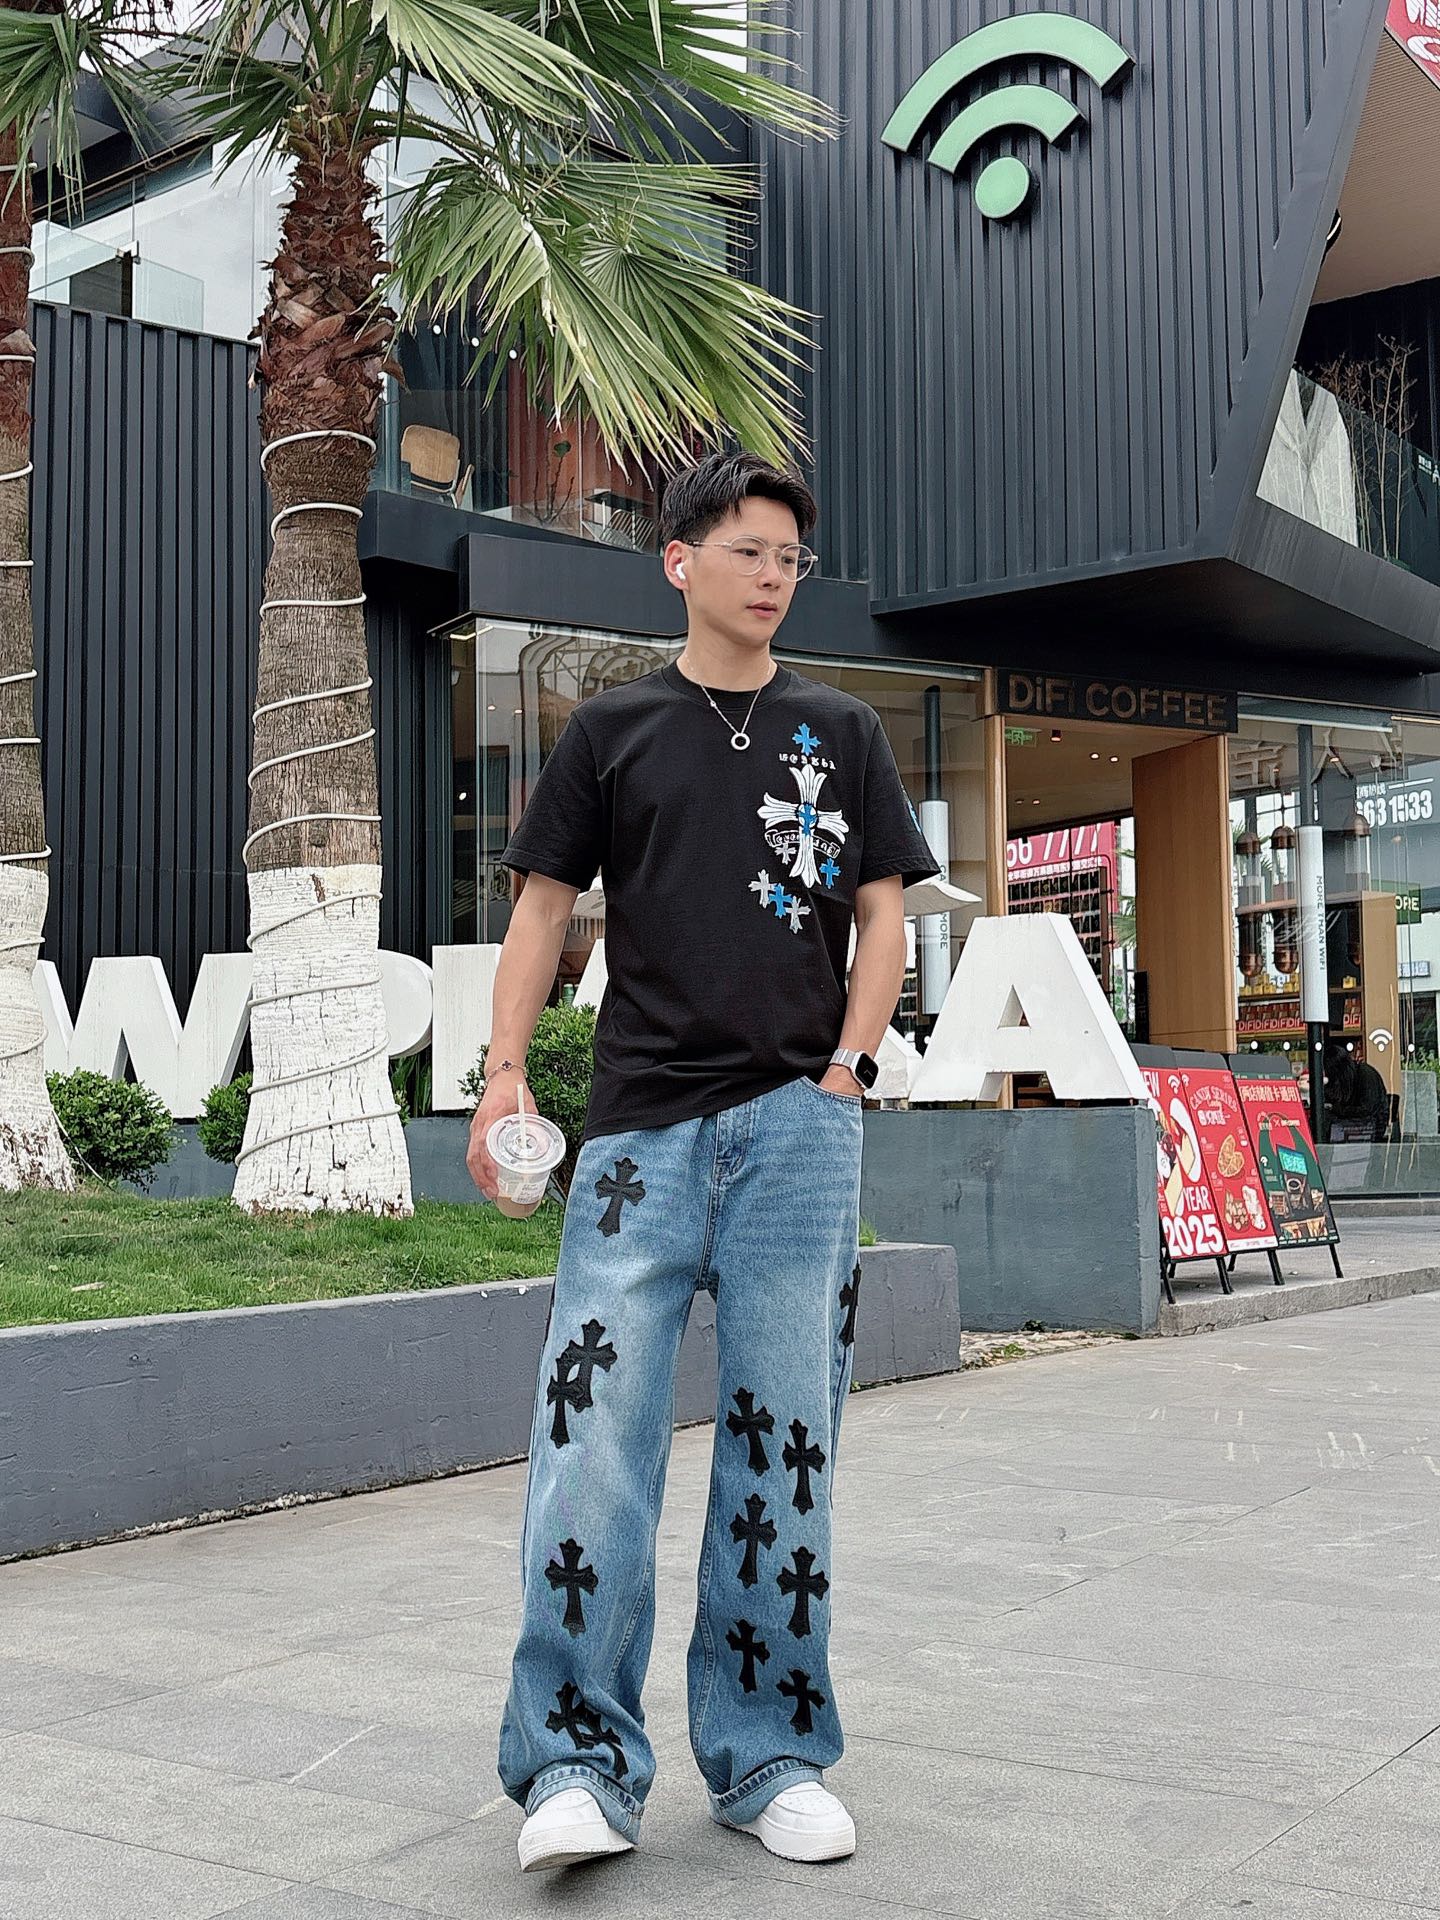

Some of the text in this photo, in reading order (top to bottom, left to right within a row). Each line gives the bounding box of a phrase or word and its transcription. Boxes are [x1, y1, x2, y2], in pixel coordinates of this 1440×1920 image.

[1085, 682, 1228, 728] COFFEE
[1316, 875, 1324, 910] MORE
[1317, 912, 1326, 944] THAN
[1183, 1186, 1211, 1212] YEAR
[1162, 1213, 1224, 1257] 2025
